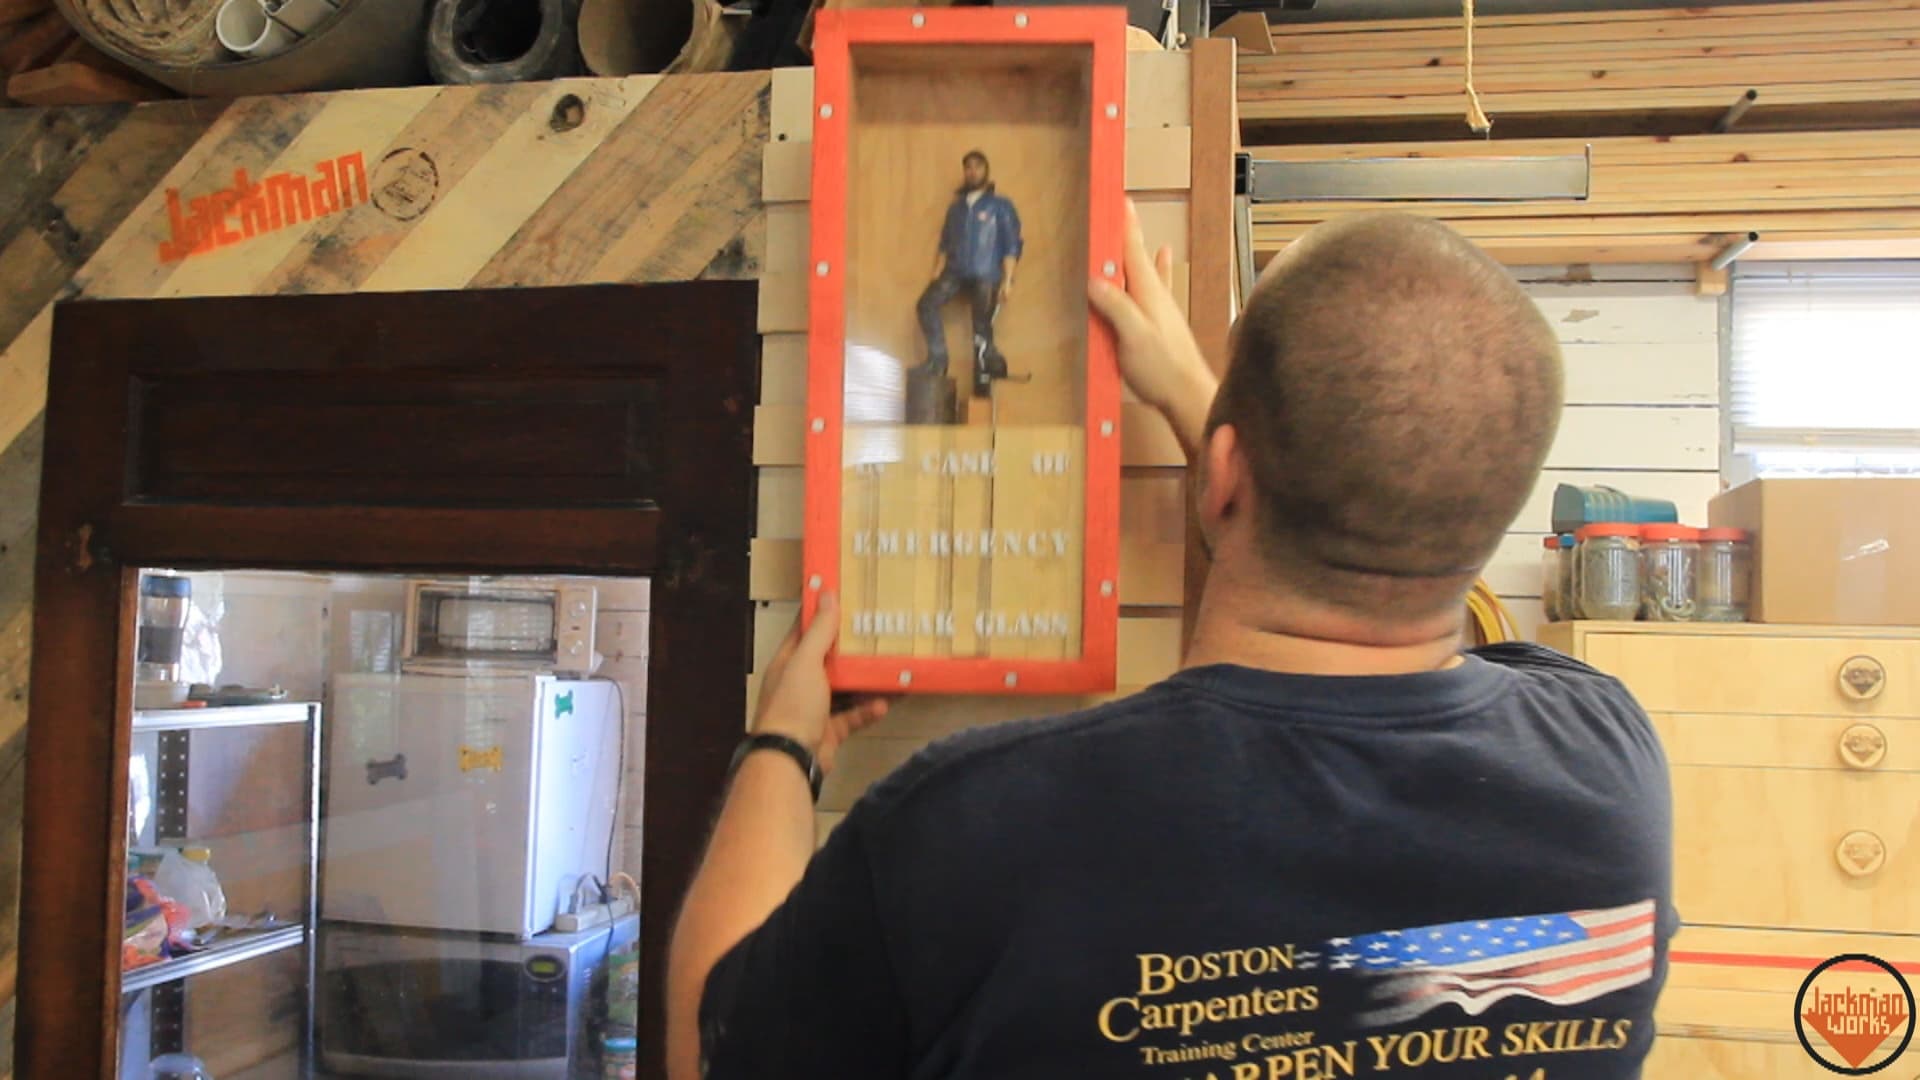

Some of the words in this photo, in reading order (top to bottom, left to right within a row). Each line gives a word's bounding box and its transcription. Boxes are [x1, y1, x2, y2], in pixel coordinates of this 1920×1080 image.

[158, 150, 369, 263] Jackman
[920, 450, 994, 475] CASE
[852, 529, 1069, 556] EMERGENCY
[852, 610, 953, 637] BREAK
[974, 610, 1068, 637] GLASS
[1136, 943, 1295, 996] BOSTON
[1098, 985, 1319, 1042] Carpenters
[1140, 1040, 1238, 1065] Training
[1242, 1031, 1315, 1053] Center
[1366, 1025, 1493, 1071] YOUR
[1502, 1017, 1632, 1056] SKILLS
